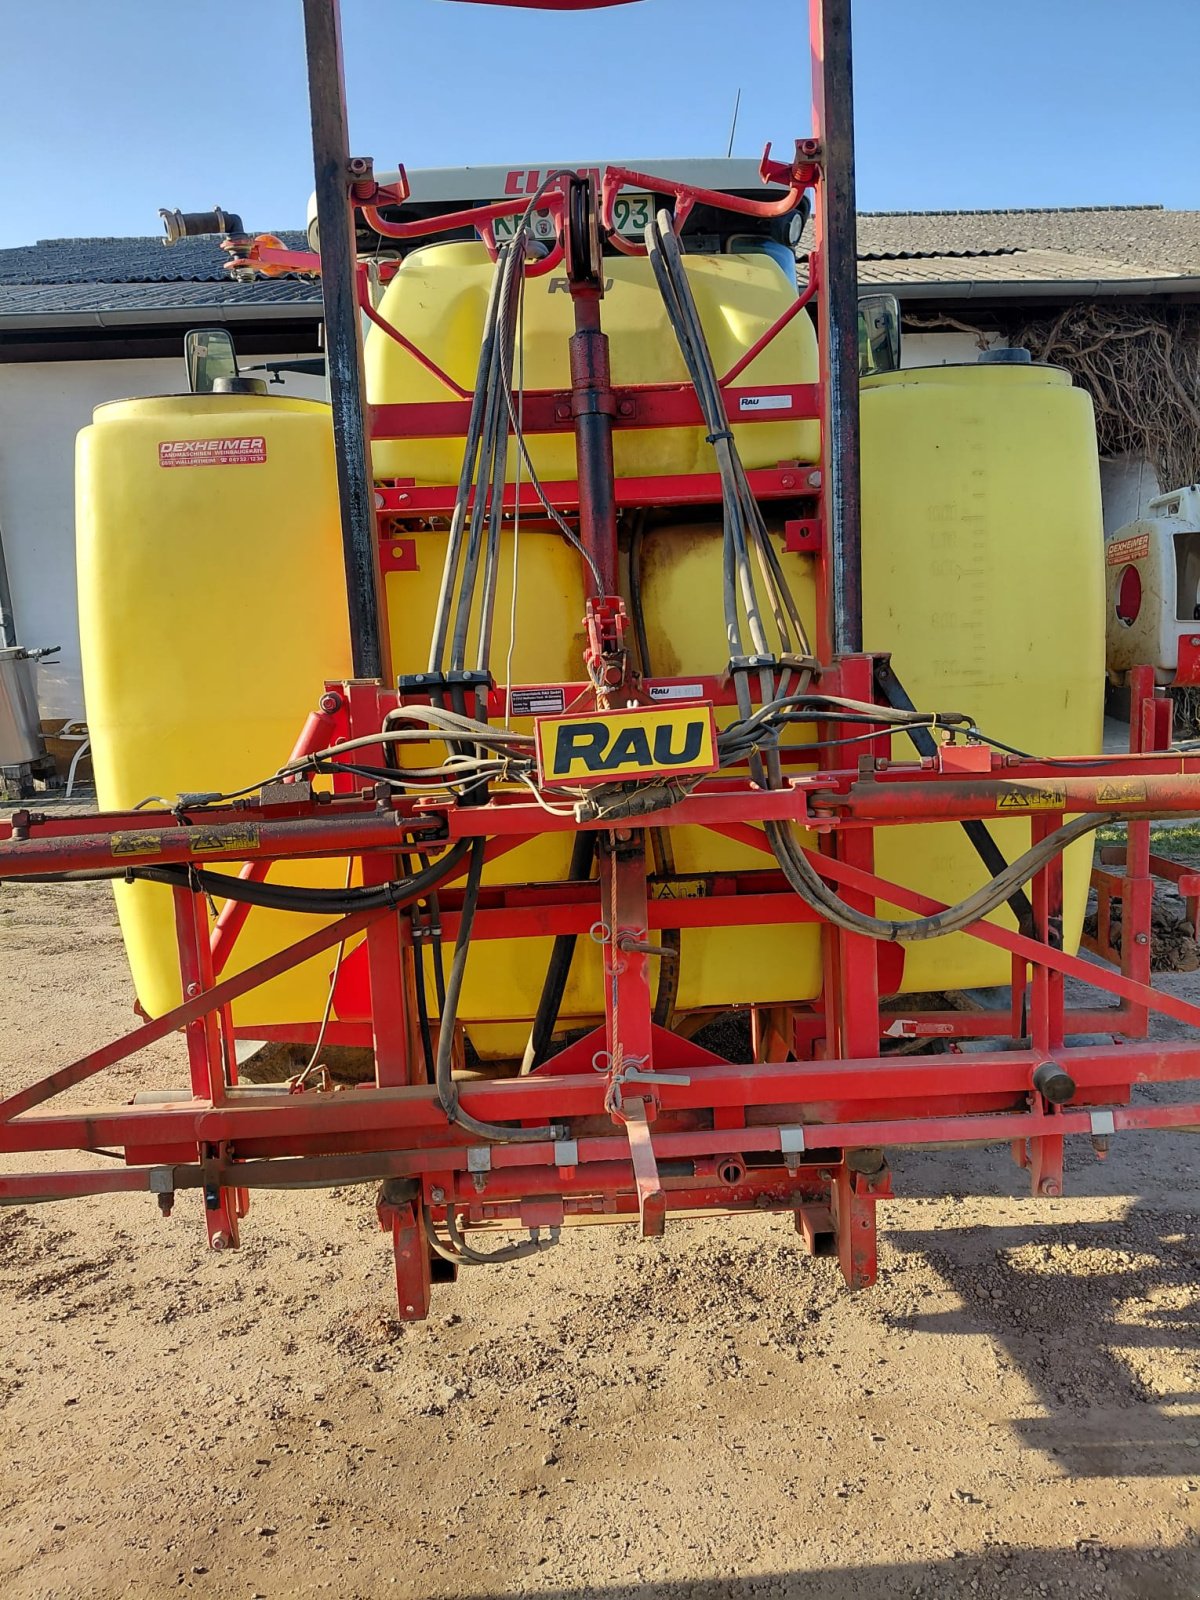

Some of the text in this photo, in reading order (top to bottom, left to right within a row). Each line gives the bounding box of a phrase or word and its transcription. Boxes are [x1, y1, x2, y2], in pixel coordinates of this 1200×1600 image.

[505, 167, 626, 194] CLA
[160, 438, 263, 453] DEXHEIMER
[1108, 535, 1149, 554] DEXHEIMER
[554, 722, 704, 774] RAU
